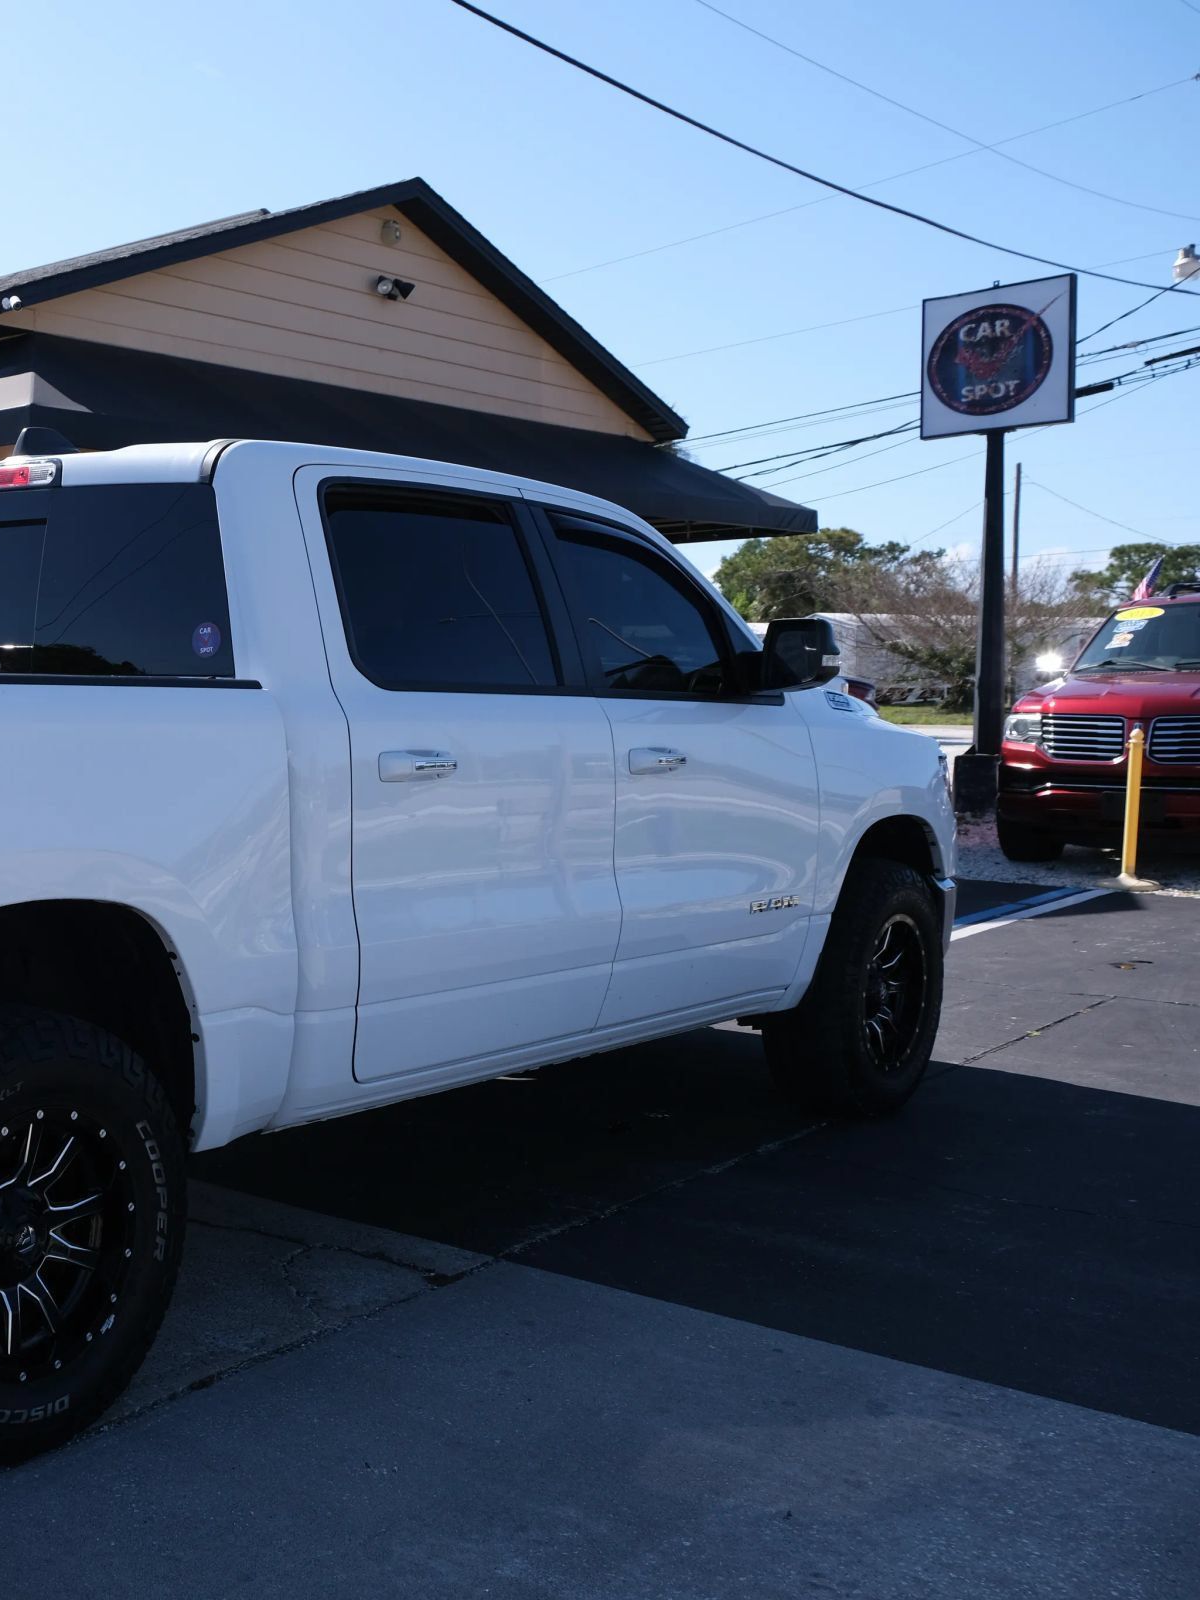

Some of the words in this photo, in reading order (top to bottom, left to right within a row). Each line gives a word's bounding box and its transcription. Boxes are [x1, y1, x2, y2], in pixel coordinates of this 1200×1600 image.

[959, 319, 1011, 342] CAR
[961, 380, 1020, 402] SPOT
[199, 646, 214, 654] SPOT
[750, 895, 800, 914] RAM
[136, 1120, 170, 1263] COOPER
